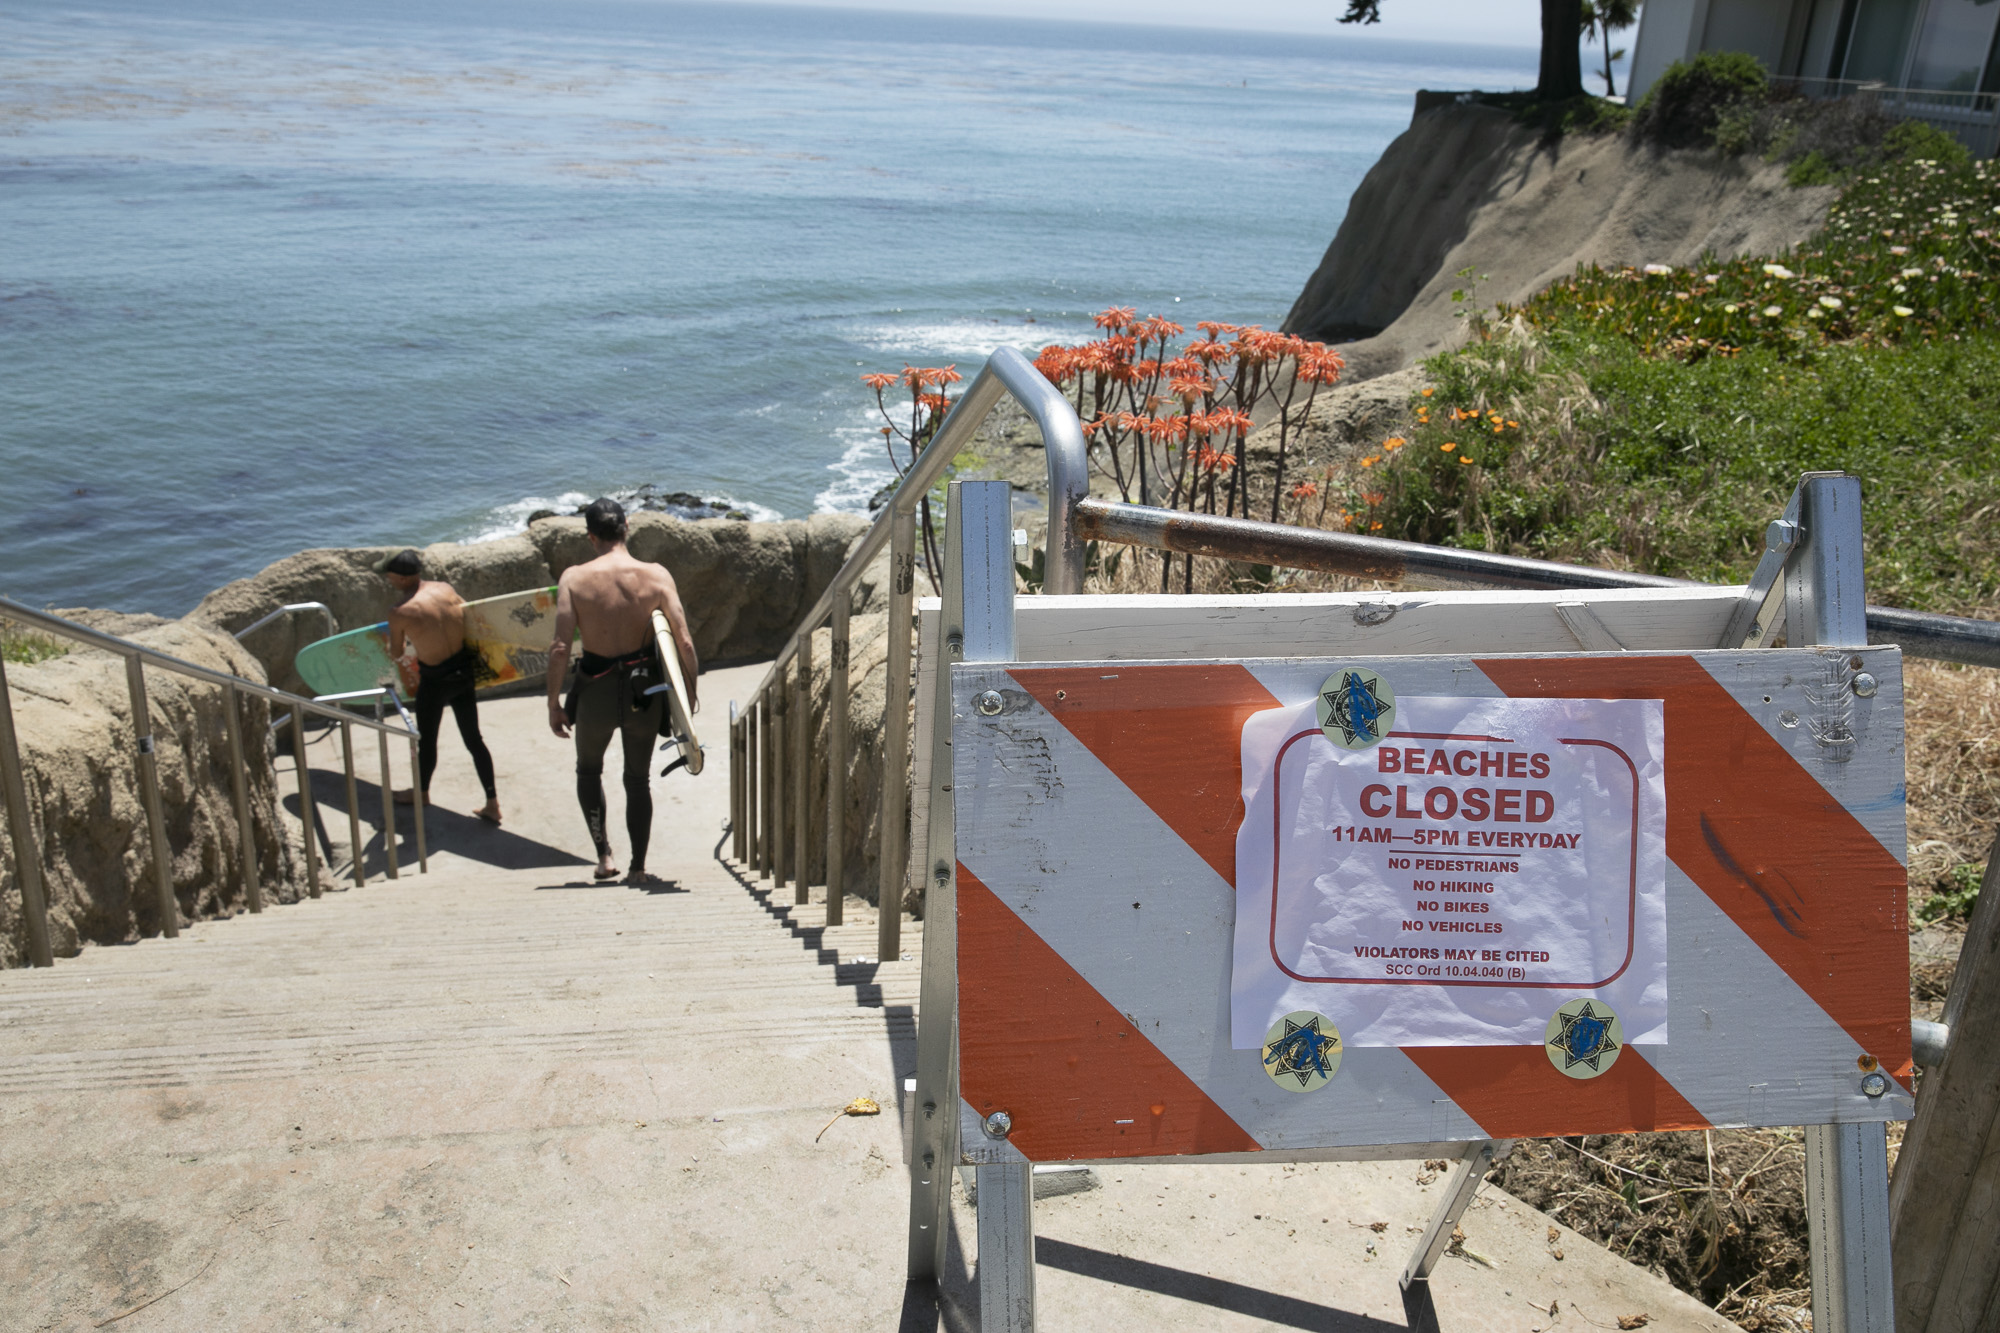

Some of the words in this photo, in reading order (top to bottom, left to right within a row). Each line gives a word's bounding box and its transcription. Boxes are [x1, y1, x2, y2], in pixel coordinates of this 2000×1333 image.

[1378, 747, 1550, 779] BEACHES
[1359, 784, 1554, 823] CLOSED
[1467, 831, 1580, 849] EVERYDAY
[1388, 858, 1410, 870] NO
[1415, 859, 1519, 873] PEDESTRIANS
[1413, 880, 1435, 891] NO
[1440, 881, 1494, 894] HIKING
[1417, 901, 1439, 912] NO
[1444, 901, 1489, 913] BIKES
[1402, 920, 1423, 931] NO
[1428, 921, 1502, 934] VEHICLES
[1354, 946, 1439, 959] VIOLATORS
[1444, 949, 1476, 961] MAY
[1481, 950, 1500, 961] BE
[1505, 951, 1550, 963] CITED
[1386, 964, 1413, 975] SCC
[1417, 964, 1441, 976] Ord
[1445, 966, 1504, 977] 10.04.040
[1507, 967, 1526, 980] (B)
